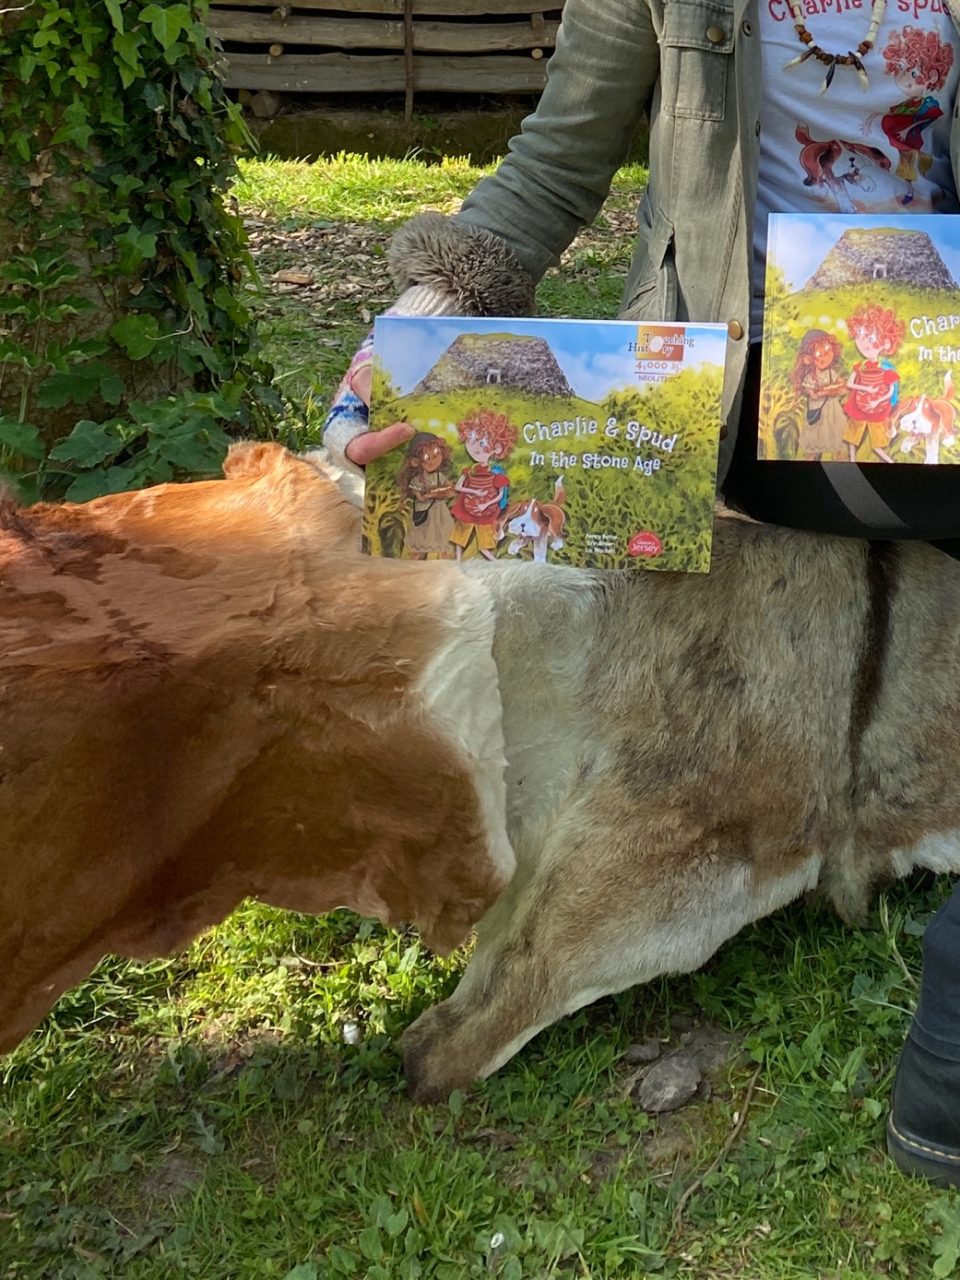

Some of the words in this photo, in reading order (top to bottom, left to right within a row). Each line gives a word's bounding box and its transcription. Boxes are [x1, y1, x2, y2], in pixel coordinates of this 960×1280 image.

[523, 416, 598, 444] Charlie
[605, 417, 619, 438] &
[626, 421, 678, 453] Spud
[550, 451, 577, 469] the
[582, 453, 629, 469] Stone
[633, 455, 661, 477] Age
[632, 543, 659, 554] Jersey
